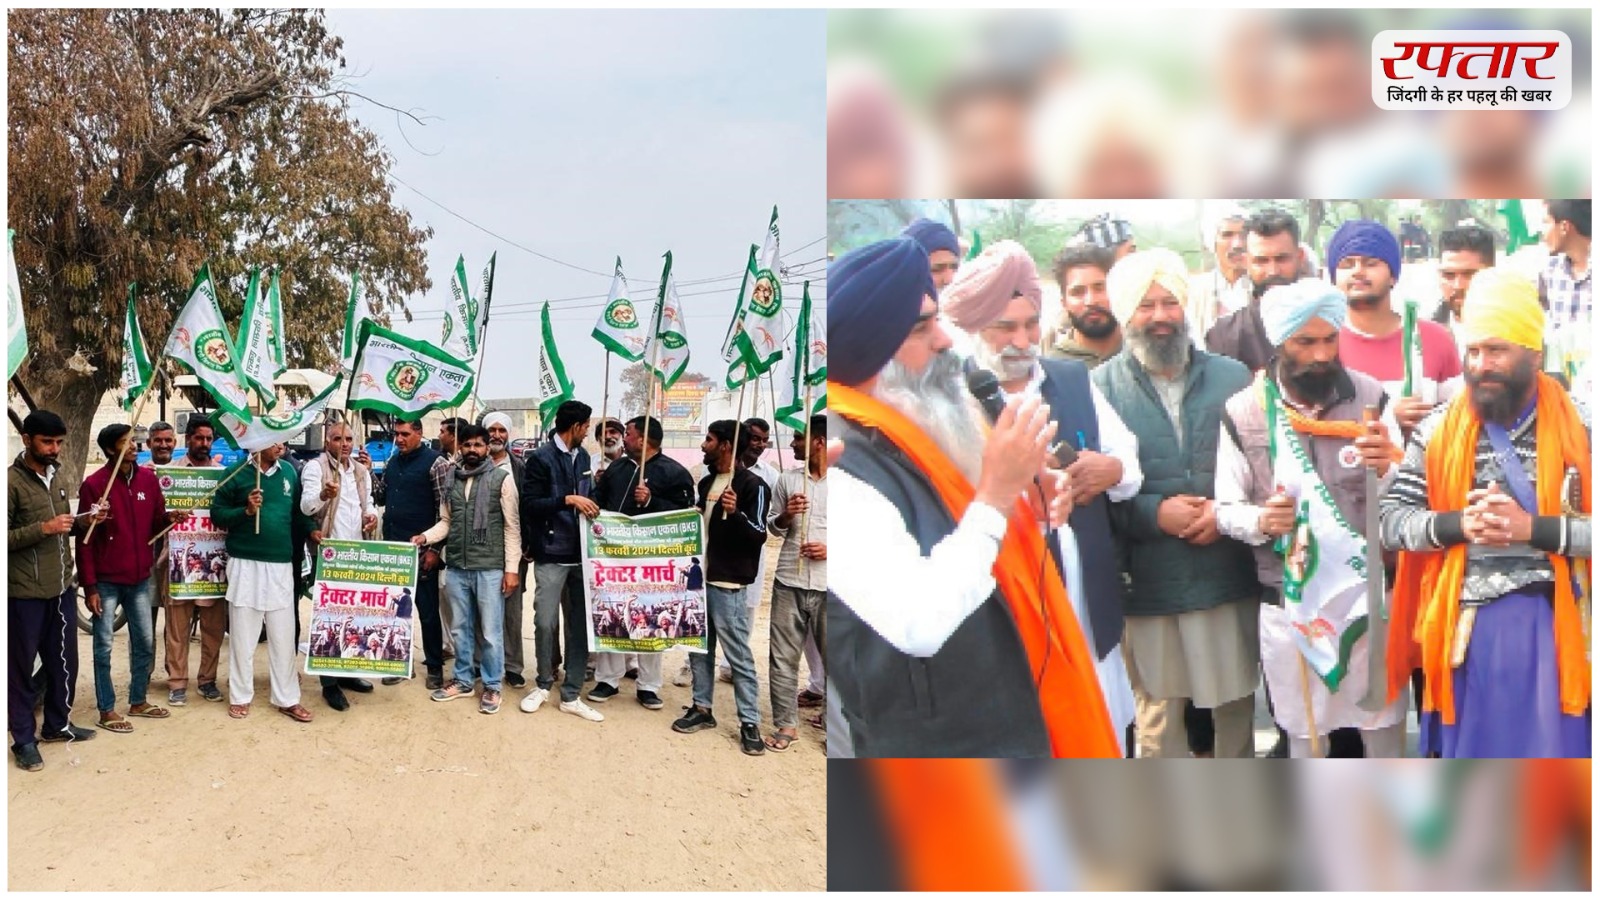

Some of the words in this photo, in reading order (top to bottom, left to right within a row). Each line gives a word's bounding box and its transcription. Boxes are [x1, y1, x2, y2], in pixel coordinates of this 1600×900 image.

[171, 498, 192, 506] फरवरी
[606, 524, 631, 537] भारतीय
[632, 524, 656, 536] किसान
[658, 524, 678, 535] एकता
[680, 522, 698, 534] (BKE)
[337, 548, 358, 560] भारतीय
[360, 549, 379, 562] किसान
[380, 555, 396, 564] एकता
[594, 547, 604, 555] 13
[606, 544, 630, 555] फरवरी
[632, 547, 656, 555] 2024
[658, 544, 682, 554] दिल्ली
[333, 570, 354, 579] फरवरी
[356, 572, 375, 580] 2024
[377, 572, 397, 582] दिल्ली
[590, 560, 636, 587] ट्रैक्टर
[641, 559, 675, 582] मार्च
[318, 582, 357, 607] ट्रैक्टर
[361, 587, 389, 607] मार्च
